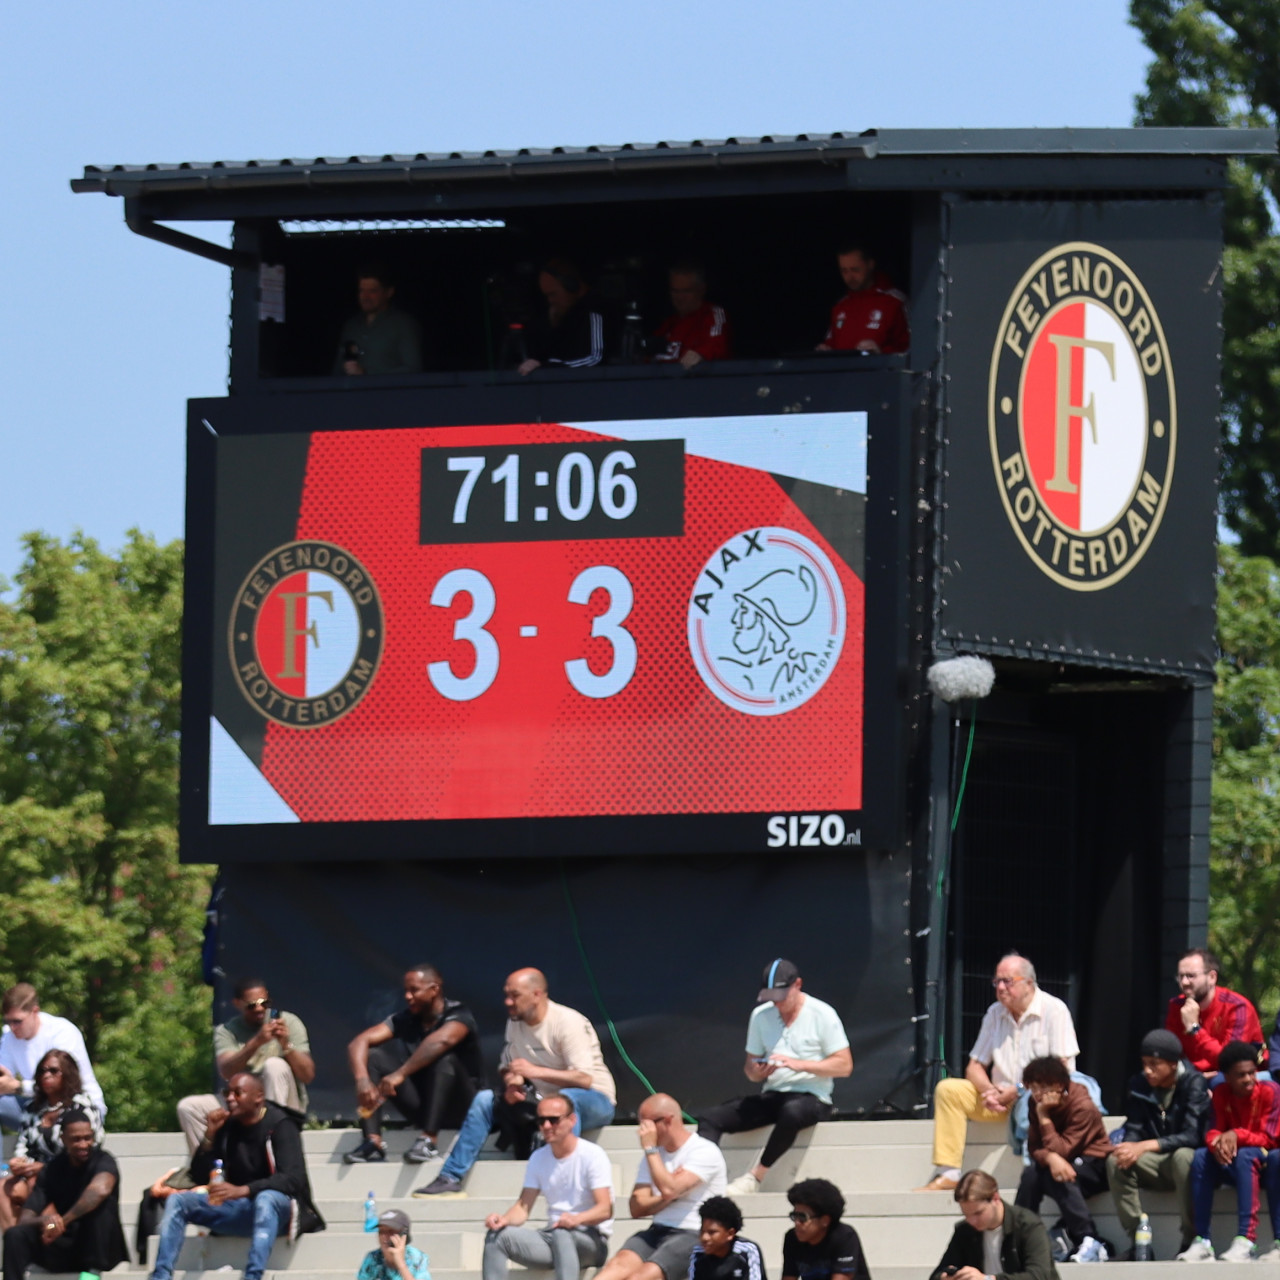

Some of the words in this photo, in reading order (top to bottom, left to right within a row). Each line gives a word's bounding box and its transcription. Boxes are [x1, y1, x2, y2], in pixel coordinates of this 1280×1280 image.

[1005, 256, 1162, 377] FEYENOORD
[1045, 333, 1117, 494] F
[447, 450, 638, 523] 71:06
[1002, 452, 1162, 576] ROTTERDAM
[241, 546, 373, 610] FEYENOORD
[693, 530, 765, 615] AJAX
[426, 567, 500, 701] 3
[564, 564, 638, 699] 3
[778, 638, 837, 704] AMSTERDAM
[240, 658, 374, 722] ROTTERDAM
